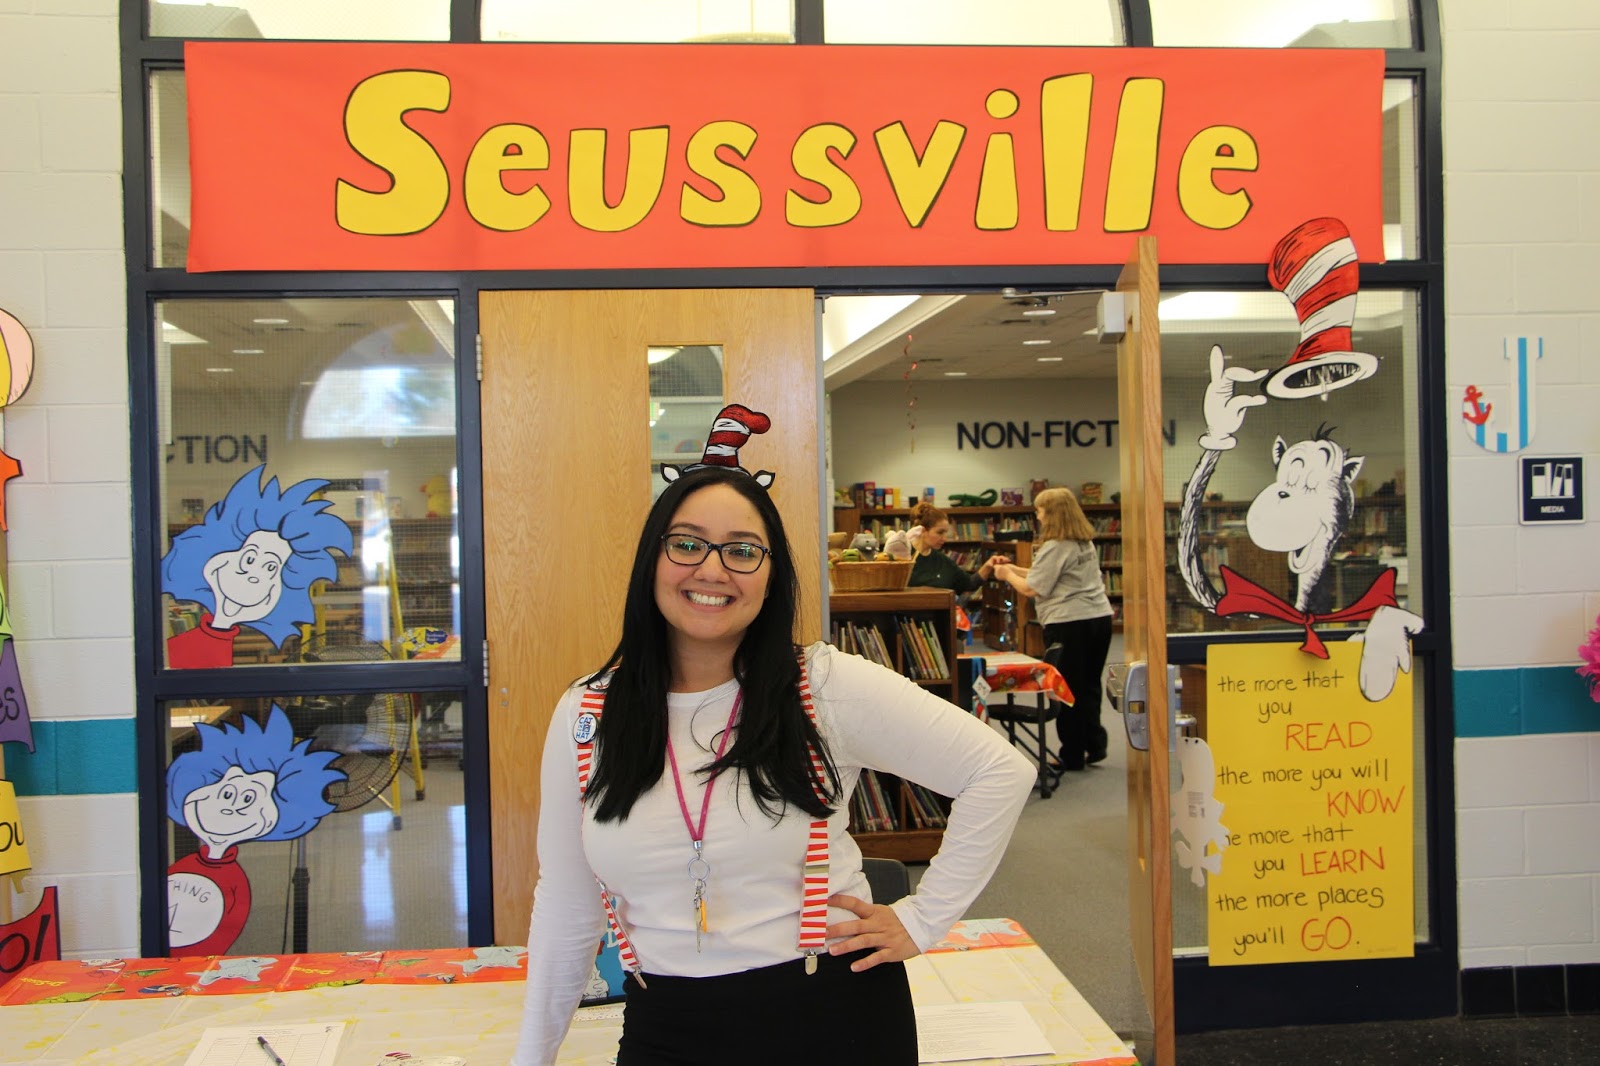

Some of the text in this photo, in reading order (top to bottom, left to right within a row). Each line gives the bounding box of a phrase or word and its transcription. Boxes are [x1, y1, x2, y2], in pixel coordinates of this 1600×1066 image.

[335, 69, 1260, 237] Seussville
[166, 434, 267, 464] TION
[956, 420, 1176, 450] NON-FICTN
[1540, 505, 1565, 513] MEDIA
[1217, 669, 1344, 693] the more that
[578, 716, 593, 725] CAT
[1258, 701, 1293, 724] you
[575, 731, 590, 740] HAT
[1285, 721, 1373, 751] READ
[1217, 758, 1388, 791] the more you will
[1327, 785, 1406, 818] KNOW
[1249, 829, 1295, 846] more
[1302, 822, 1354, 844] that
[1254, 846, 1386, 880] you LEARN
[168, 879, 212, 904] HING
[1215, 886, 1385, 912] the more places
[1233, 925, 1285, 956] you'll
